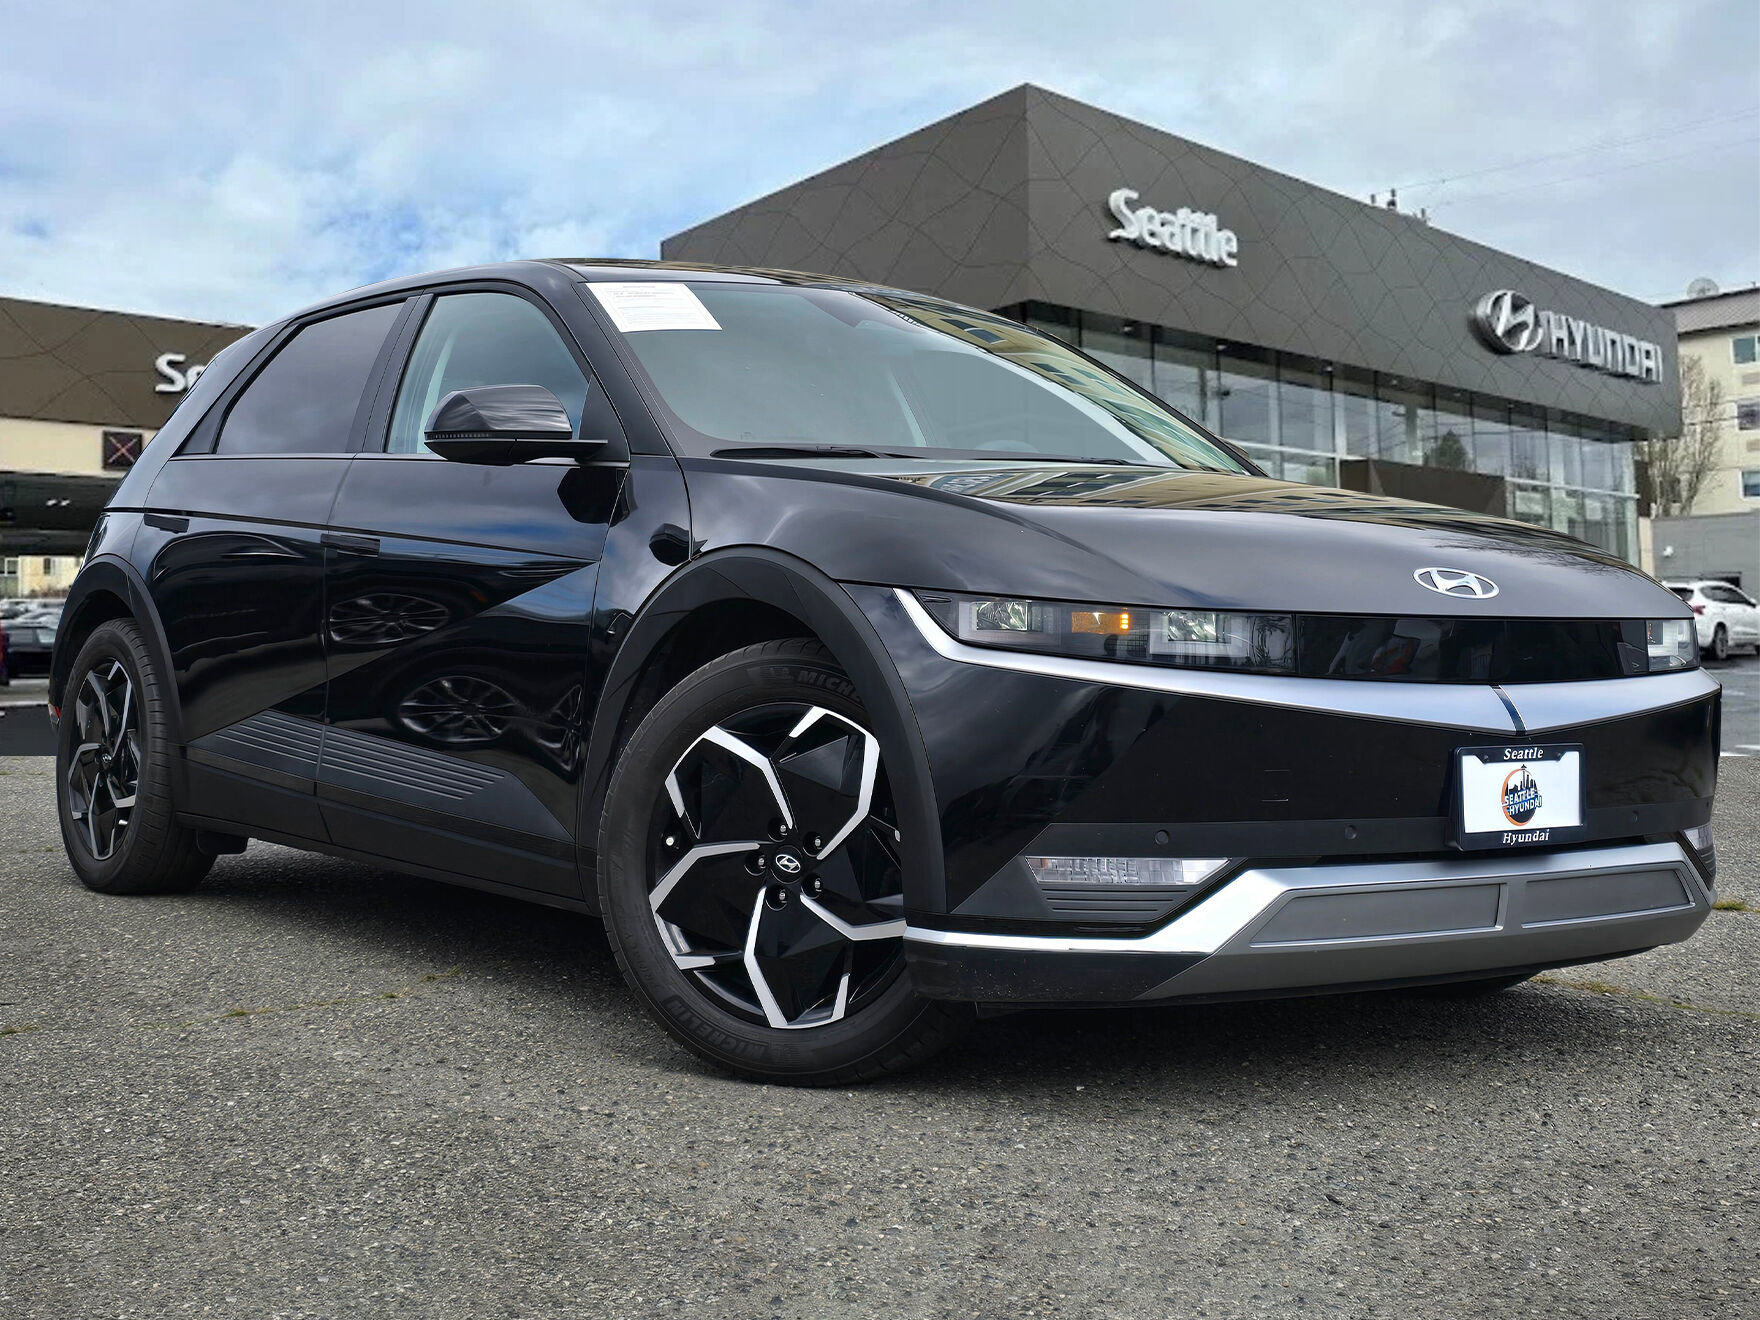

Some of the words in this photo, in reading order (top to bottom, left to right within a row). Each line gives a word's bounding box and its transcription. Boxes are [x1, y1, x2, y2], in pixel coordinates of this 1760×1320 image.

[1108, 188, 1238, 266] Seattle
[1541, 311, 1662, 382] HYUNDAI
[798, 670, 863, 702] MICH
[1504, 747, 1544, 760] Seattle
[1504, 789, 1535, 806] SEATTLE
[1509, 795, 1542, 815] HYUNDAI
[1502, 829, 1550, 845] Hyundai
[666, 1001, 766, 1059] MICHELIN
